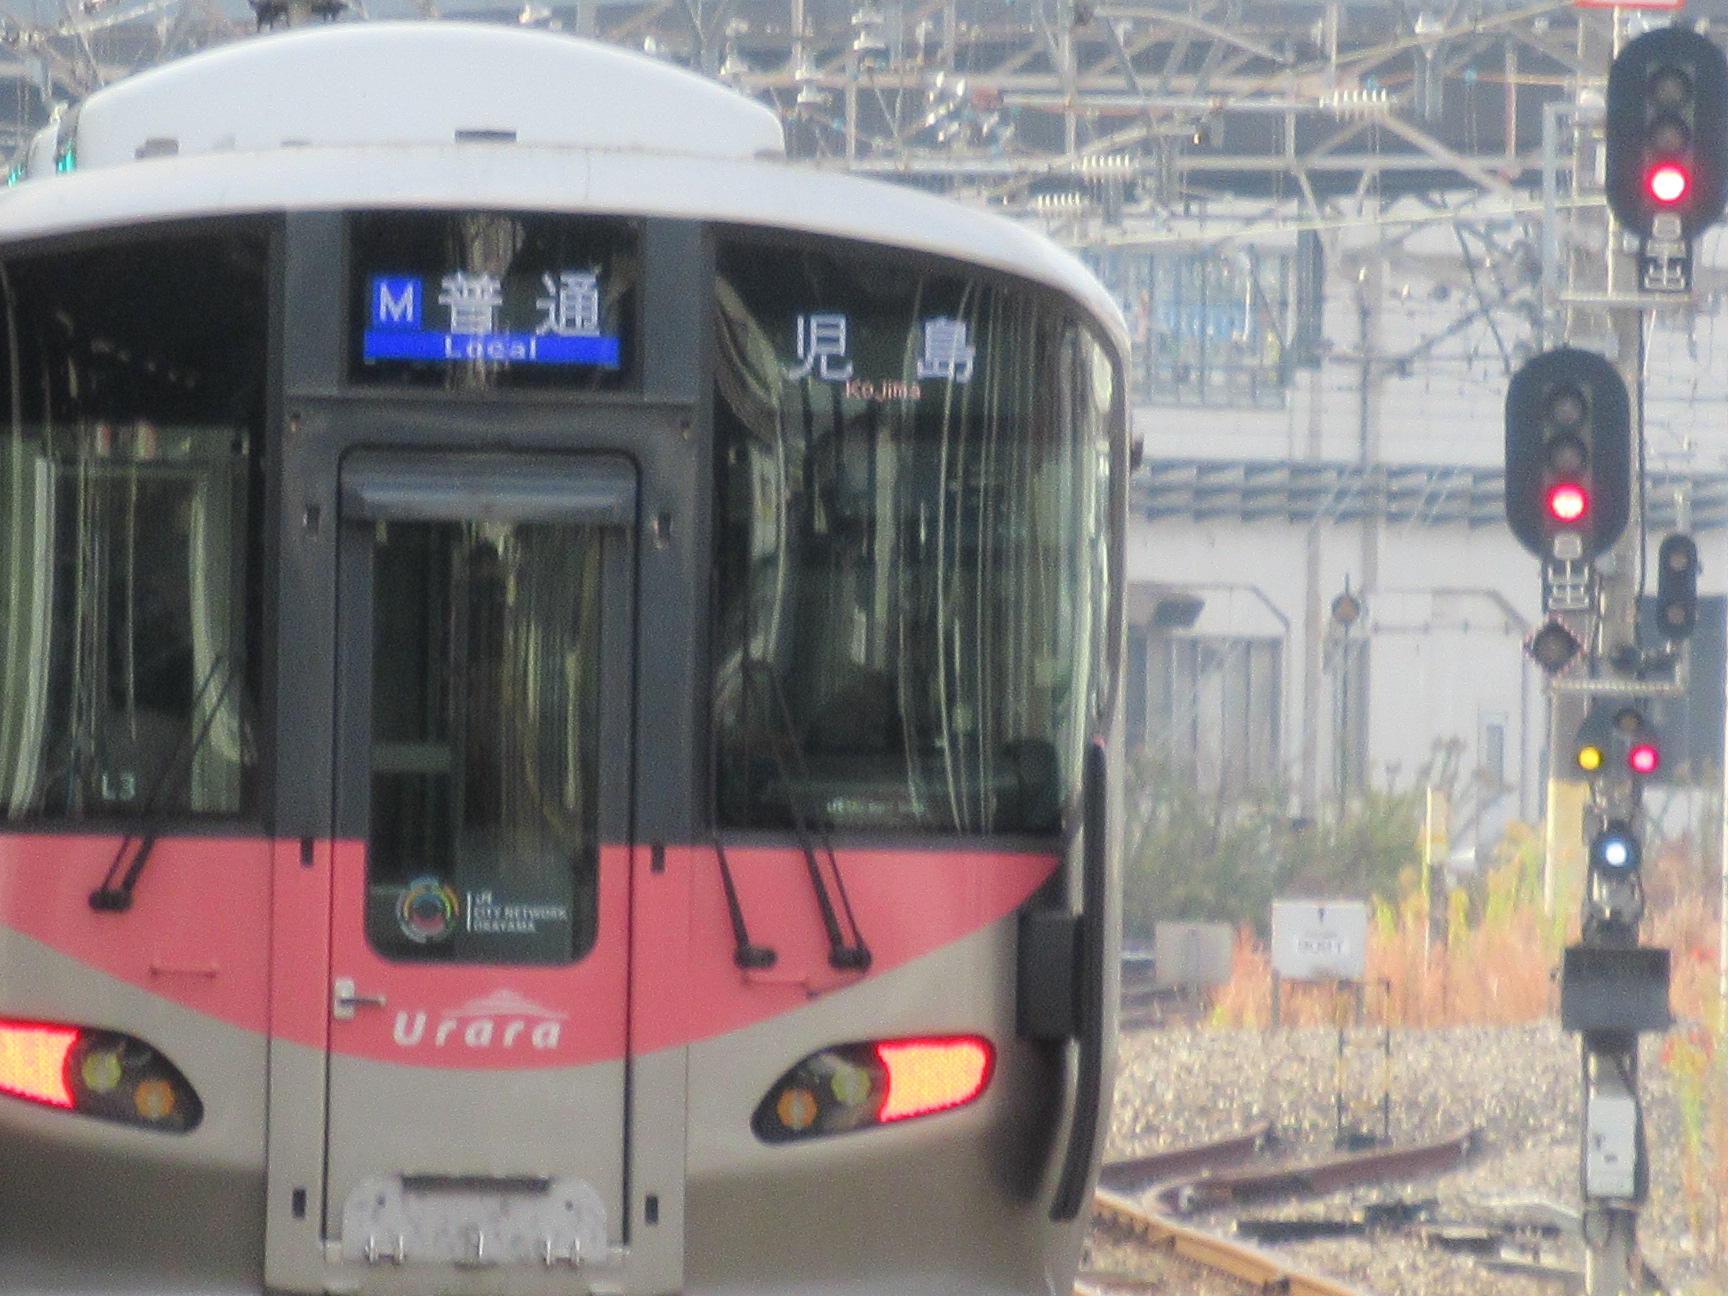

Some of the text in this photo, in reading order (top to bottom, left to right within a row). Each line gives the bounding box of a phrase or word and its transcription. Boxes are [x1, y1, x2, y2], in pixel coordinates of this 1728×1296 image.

[379, 270, 600, 336] M 普通
[445, 334, 537, 360] Local
[786, 314, 977, 382] 児島
[844, 380, 921, 402] Kojima
[394, 1011, 561, 1048] Urara
